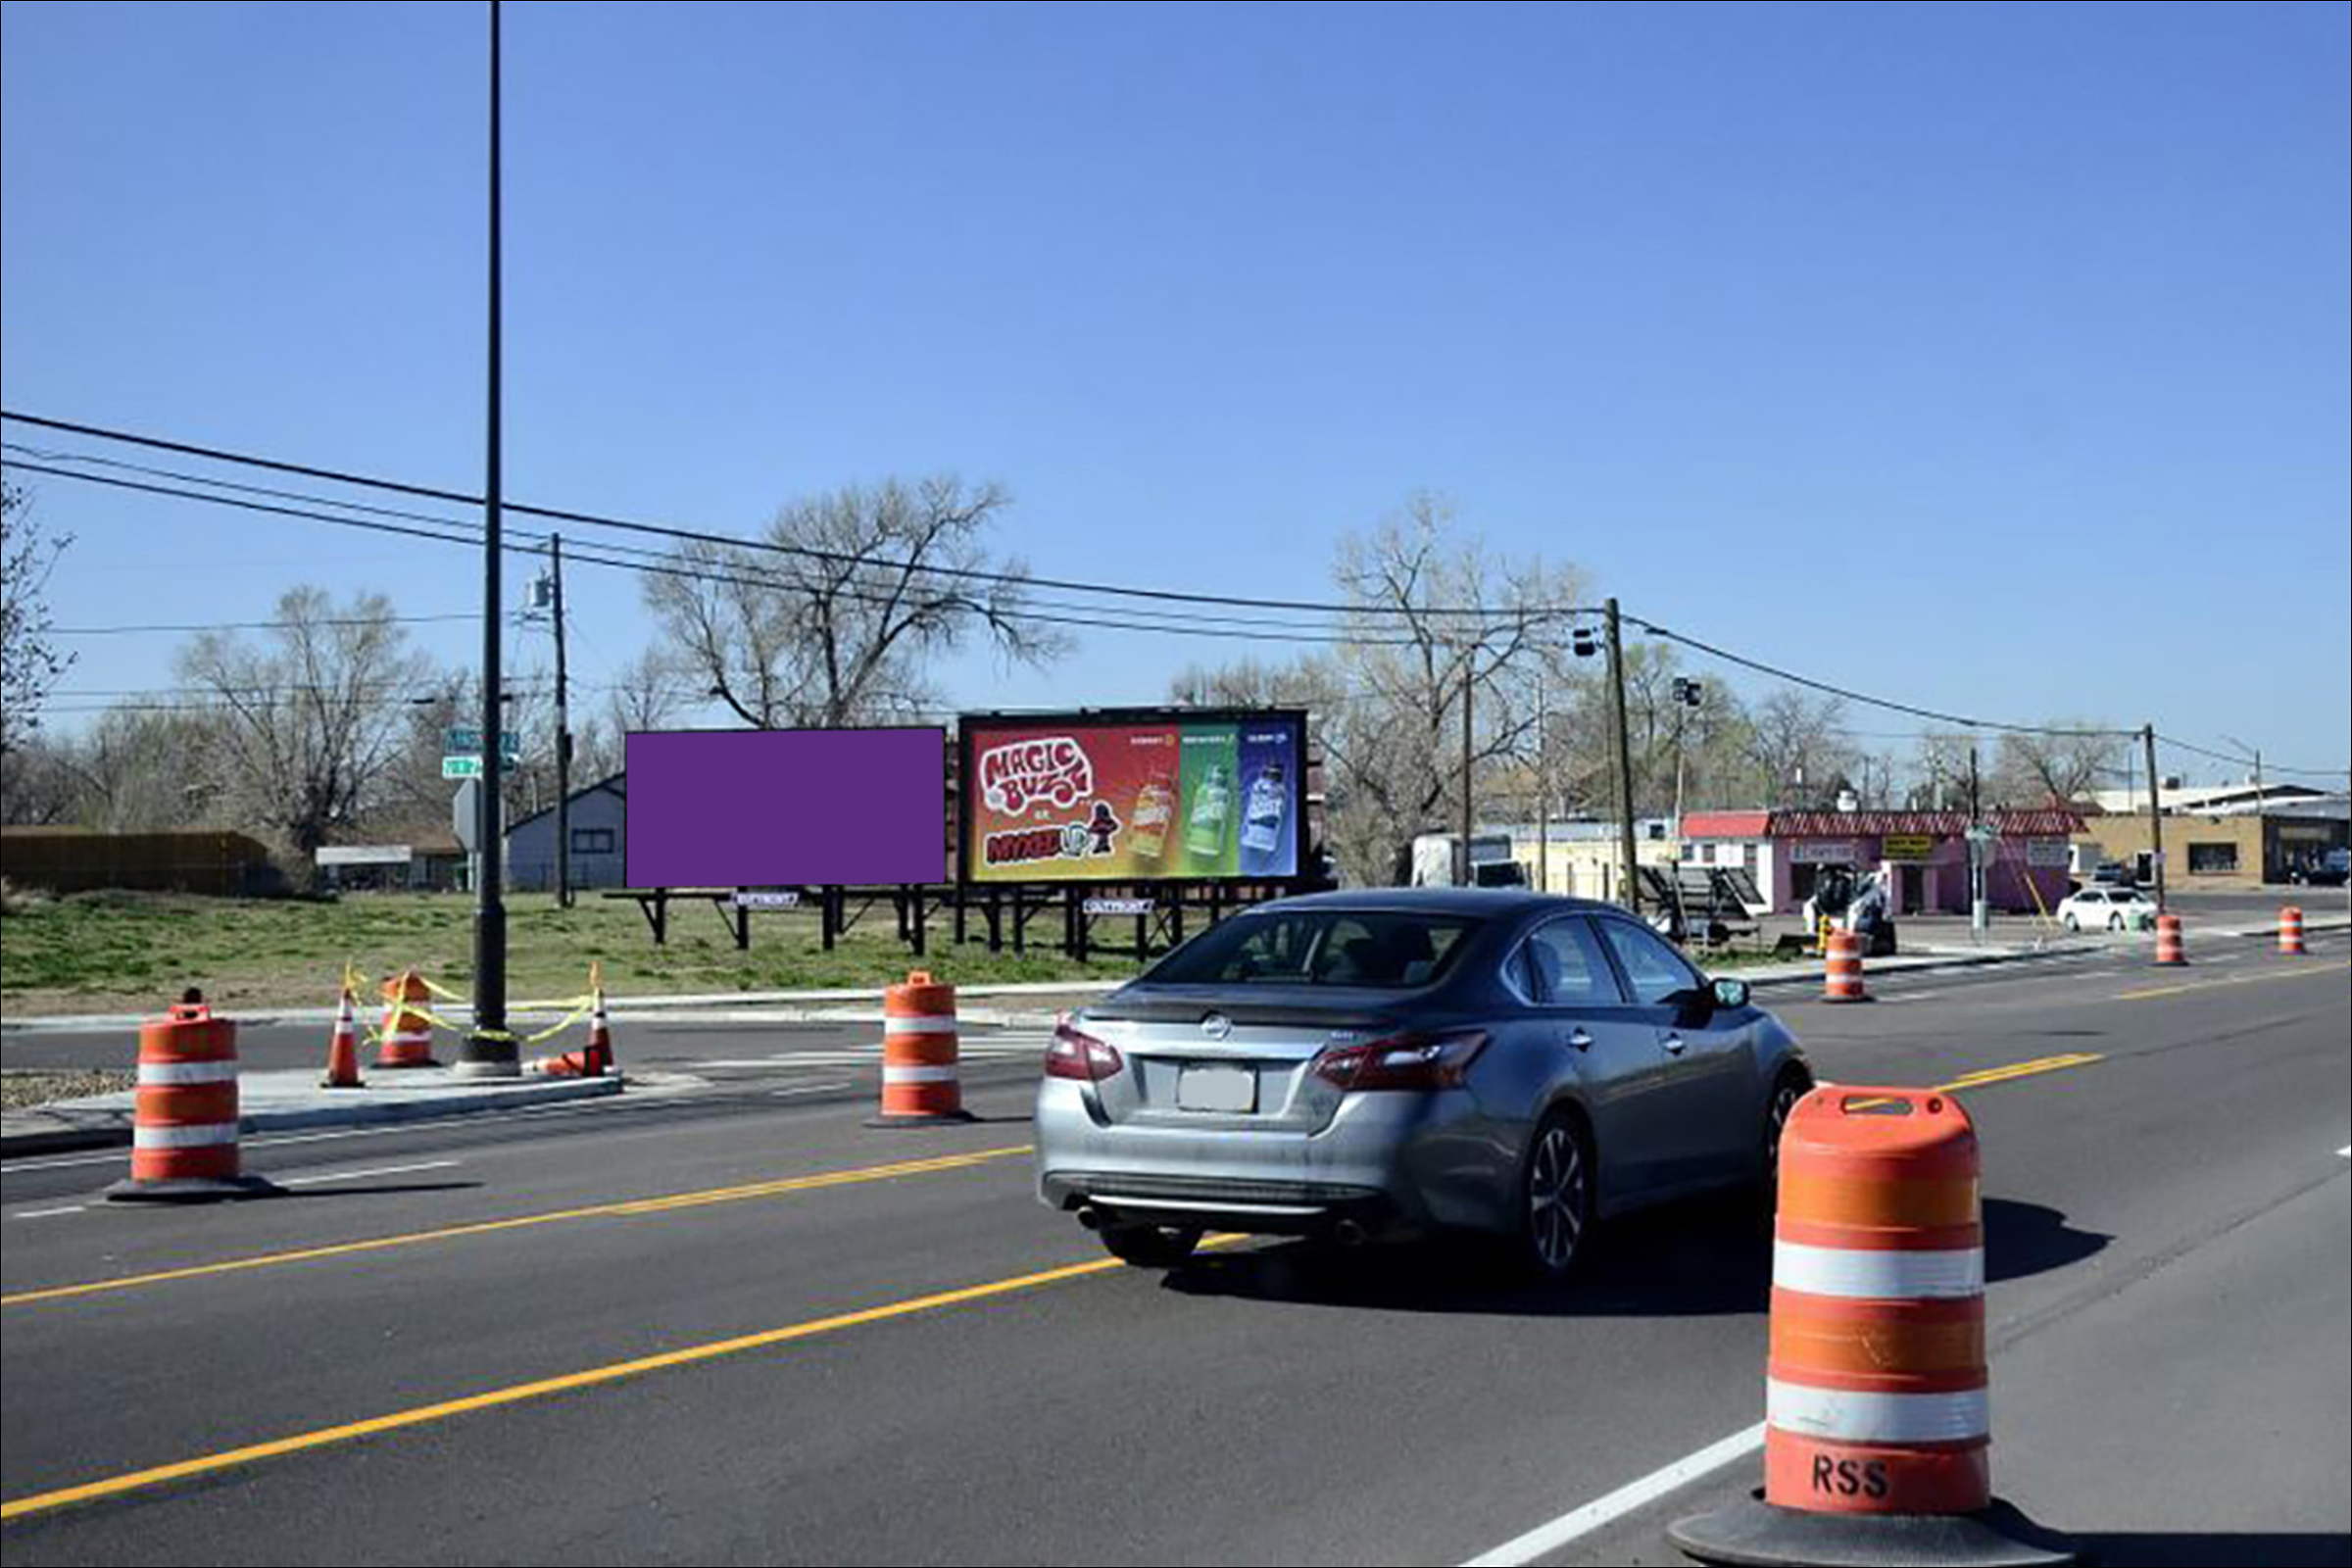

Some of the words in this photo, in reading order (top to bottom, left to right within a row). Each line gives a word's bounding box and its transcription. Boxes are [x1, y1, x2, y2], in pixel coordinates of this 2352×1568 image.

[985, 742, 1077, 788] MAGIC
[998, 757, 1088, 810] BUZZ
[1814, 1454, 1887, 1498] RSS
